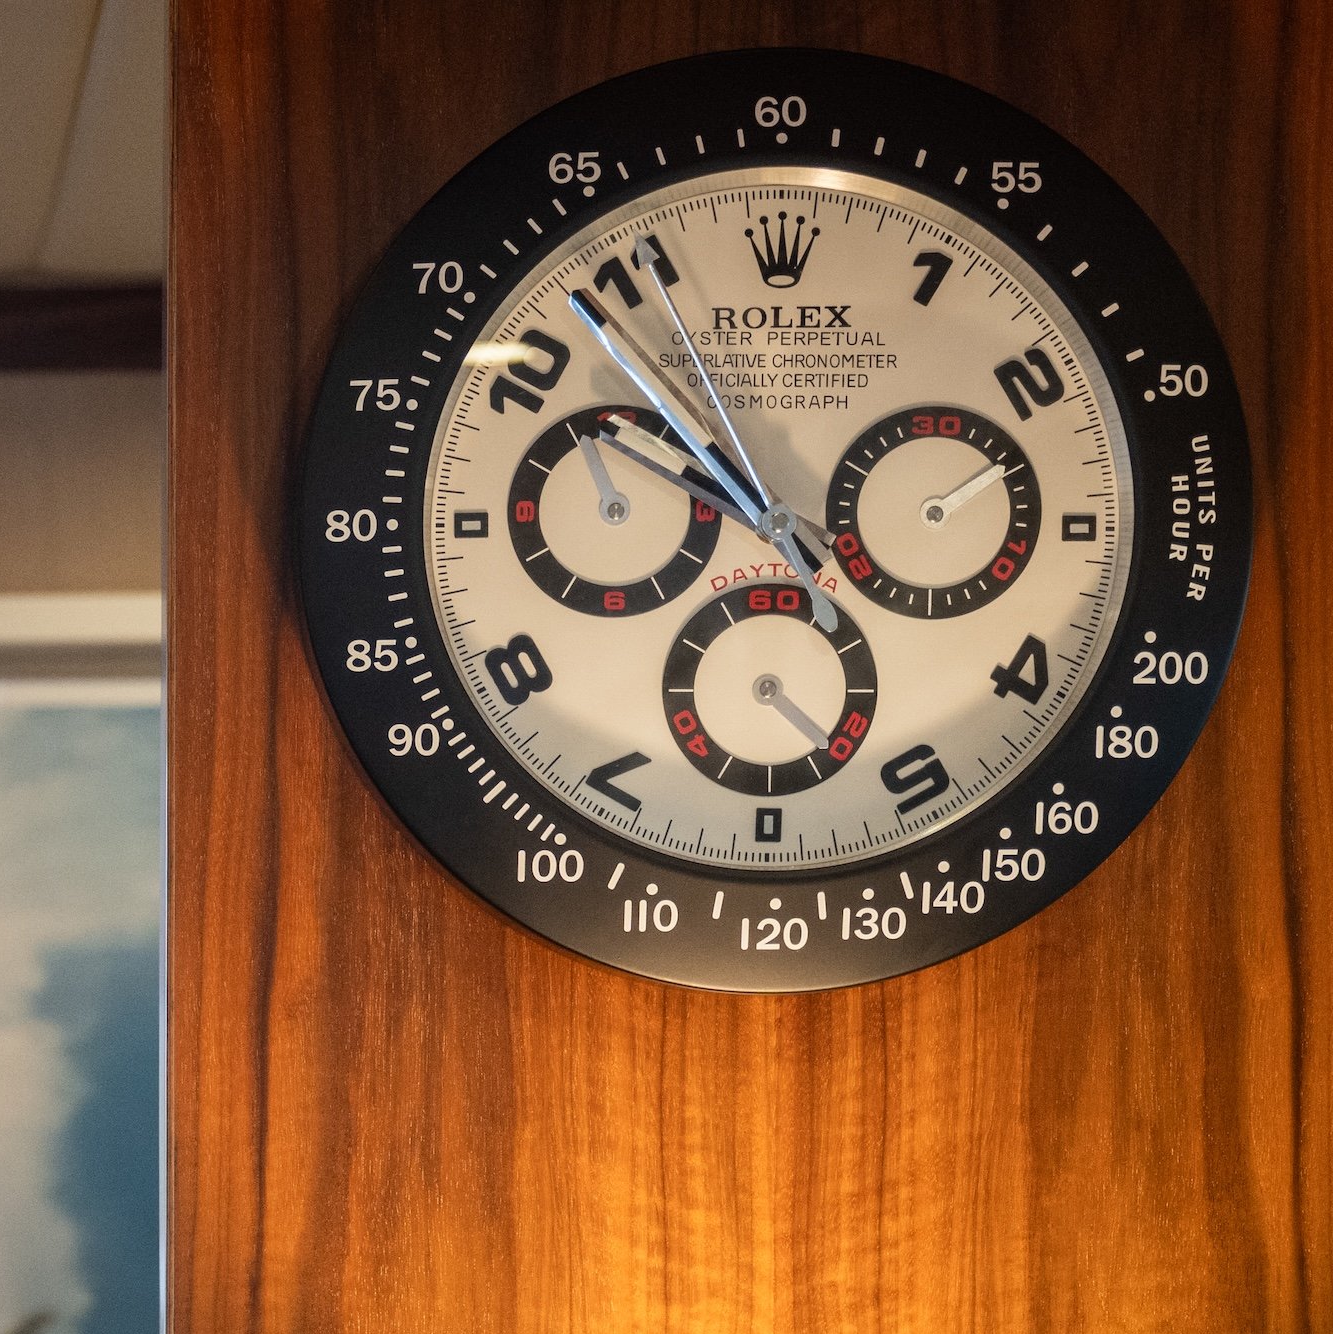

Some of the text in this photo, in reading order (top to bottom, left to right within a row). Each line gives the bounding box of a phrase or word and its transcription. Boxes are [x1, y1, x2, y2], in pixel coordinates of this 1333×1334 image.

[754, 96, 807, 128] 60
[548, 151, 602, 185] 65
[990, 162, 1043, 194] 55
[412, 261, 464, 295] 70
[593, 234, 680, 310] 11
[913, 252, 953, 307] 1
[711, 305, 852, 330] ROLEX
[767, 331, 886, 346] PERPETUAL
[489, 329, 571, 414] 10
[772, 354, 898, 369] CHRONOMETER
[349, 379, 401, 412] 75
[783, 373, 869, 388] CERTIFIED
[993, 348, 1065, 421] 2
[1159, 364, 1209, 397] 50
[707, 394, 849, 410] COSMOGRAPH
[911, 415, 961, 436] 30
[324, 509, 378, 542] 80
[1168, 474, 1191, 562] HOUR
[1186, 434, 1217, 601] UNITS PER
[836, 532, 873, 581] 20
[991, 540, 1027, 581] 10
[603, 591, 626, 610] 6
[748, 590, 800, 611] 60
[345, 639, 399, 672] 85
[484, 634, 553, 706] 8
[990, 634, 1049, 706] 4
[1132, 651, 1209, 685] 200
[387, 723, 441, 757] 90
[672, 709, 709, 758] 40
[829, 711, 869, 761] 20
[1095, 725, 1159, 759] 180
[585, 751, 652, 812] 7
[880, 744, 951, 815] 5
[1035, 801, 1099, 835] 160
[517, 849, 584, 883] 100
[982, 848, 1046, 882] 150
[921, 881, 985, 914] 140
[623, 899, 679, 933] 110
[841, 906, 907, 940] 130
[740, 917, 809, 951] 120
